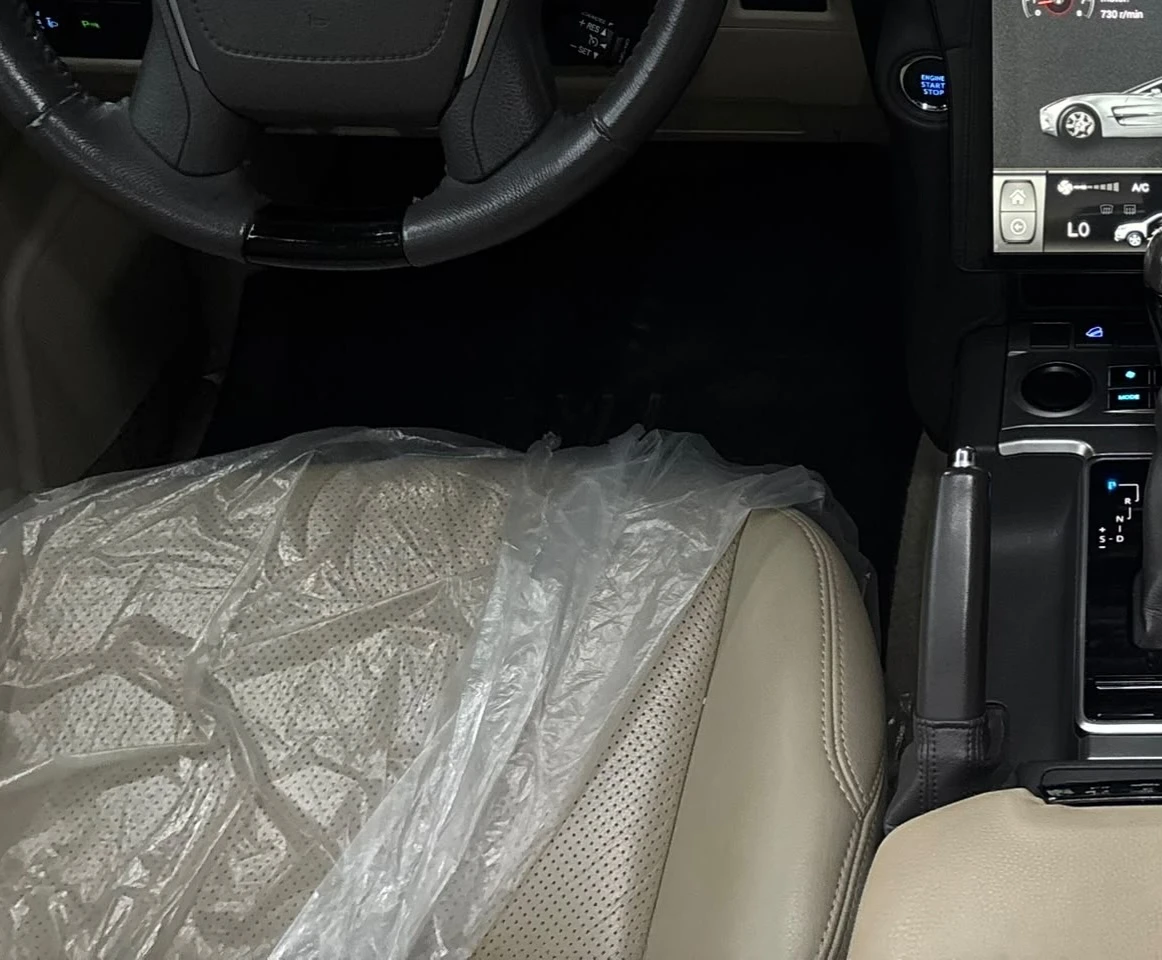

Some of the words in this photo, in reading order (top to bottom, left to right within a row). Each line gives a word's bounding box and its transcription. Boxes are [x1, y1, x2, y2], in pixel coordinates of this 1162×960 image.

[1100, 9, 1118, 19] 730
[1119, 9, 1144, 19] r/min
[921, 81, 946, 89] START
[922, 88, 945, 96] STOP
[1131, 182, 1150, 193] A/C
[1067, 222, 1090, 238] LO
[1117, 393, 1141, 401] MODE
[1107, 480, 1117, 490] P
[1124, 497, 1132, 505] R
[1115, 515, 1124, 523] N
[1098, 535, 1106, 543] S
[1115, 535, 1124, 543] D
